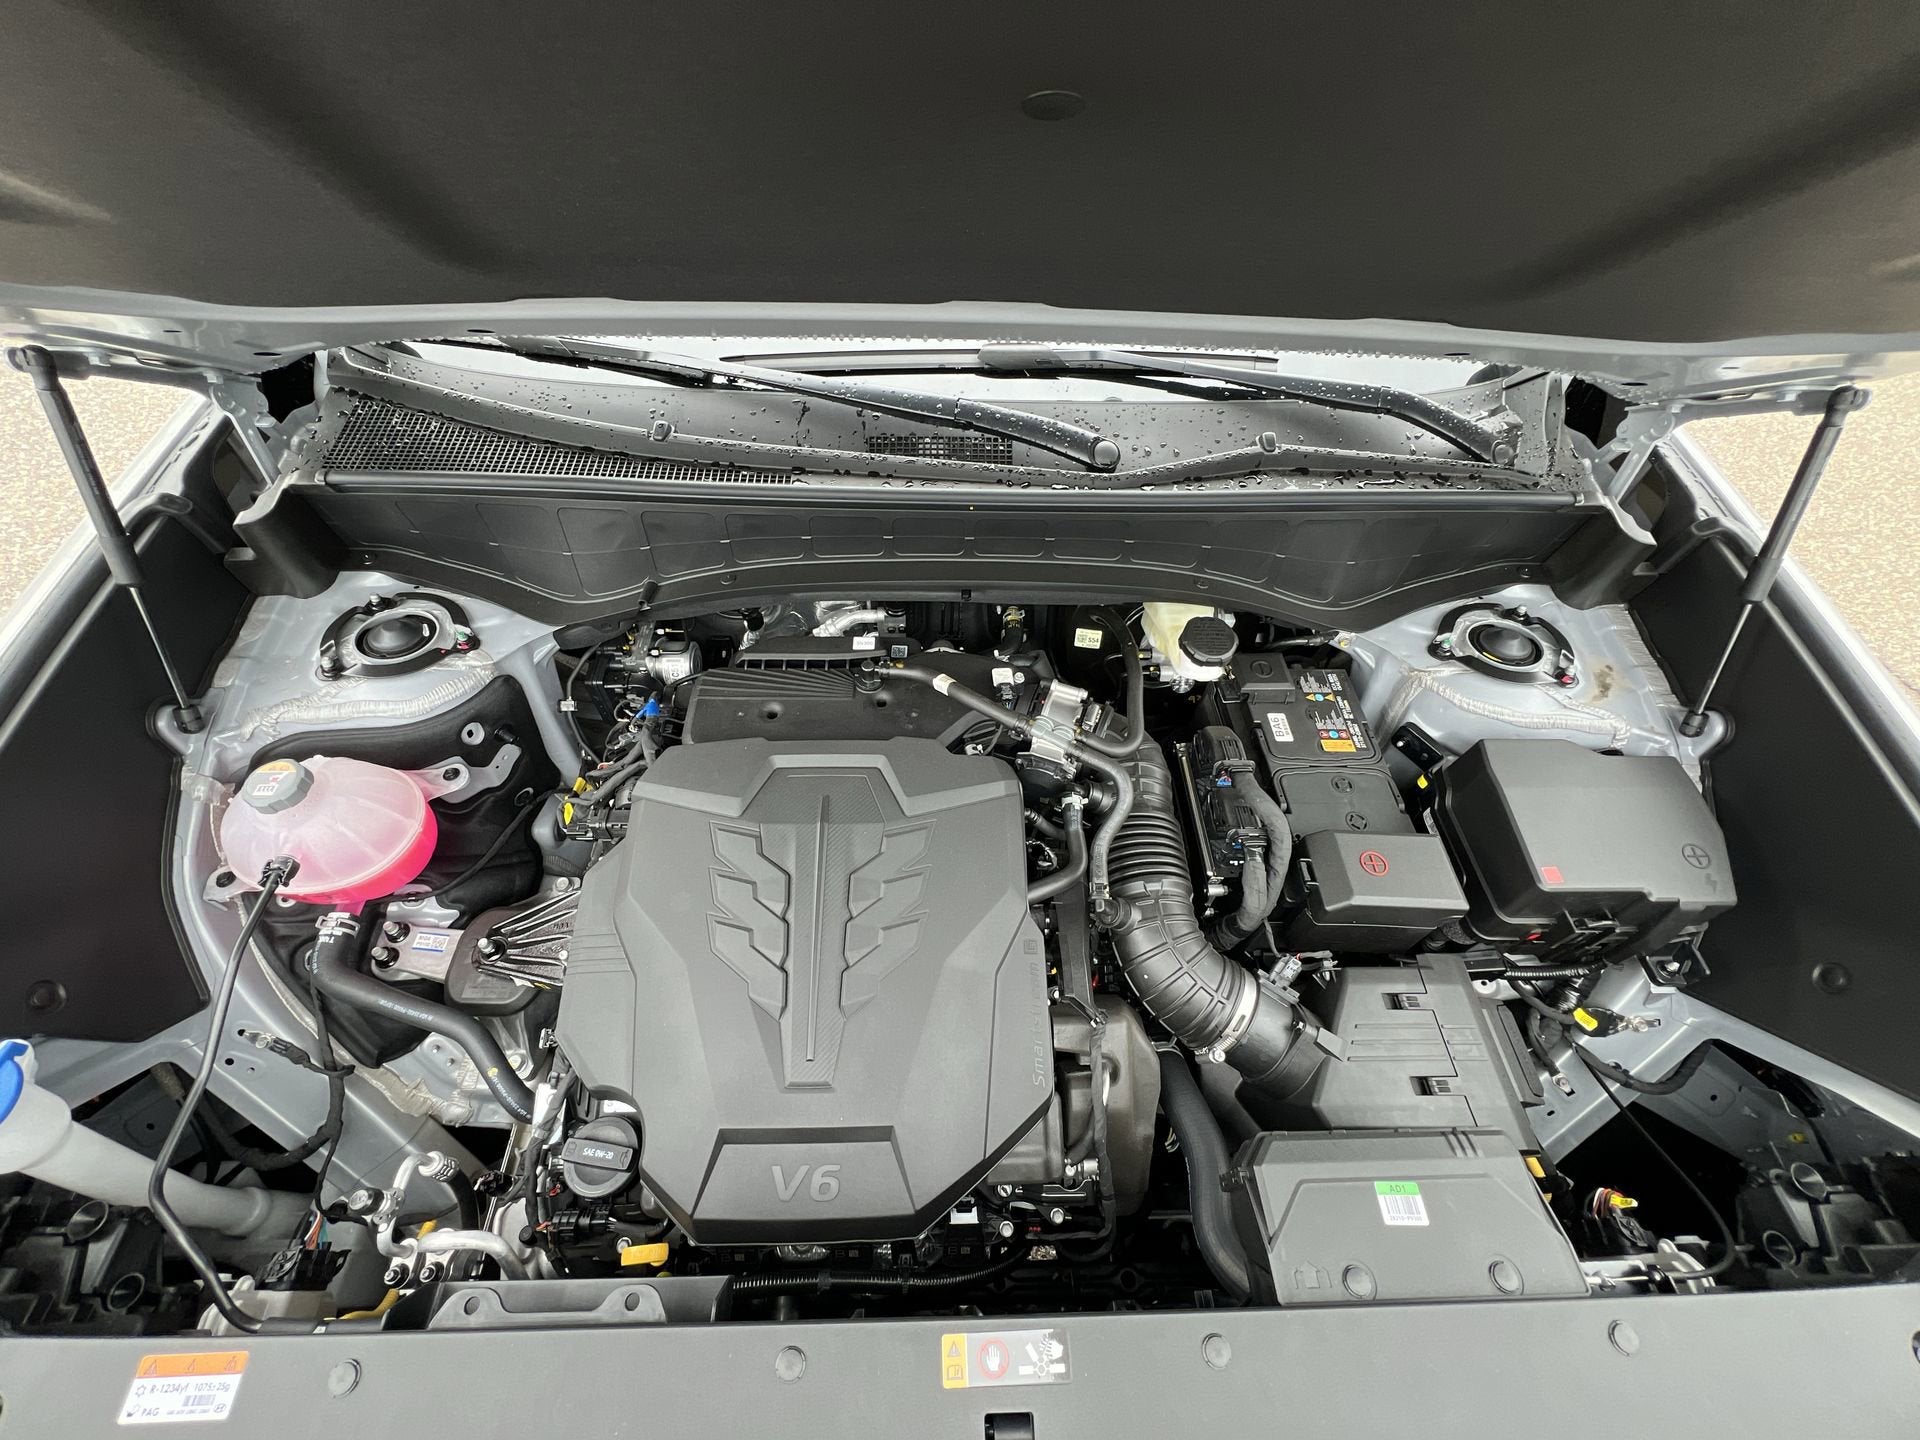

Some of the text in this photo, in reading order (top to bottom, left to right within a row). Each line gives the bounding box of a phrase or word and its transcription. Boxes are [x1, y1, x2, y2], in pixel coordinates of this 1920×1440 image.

[1270, 717, 1285, 738] BA6
[582, 1147, 614, 1160] SAE 0W-20
[771, 1165, 841, 1202] V6
[141, 1407, 160, 1417] PAG
